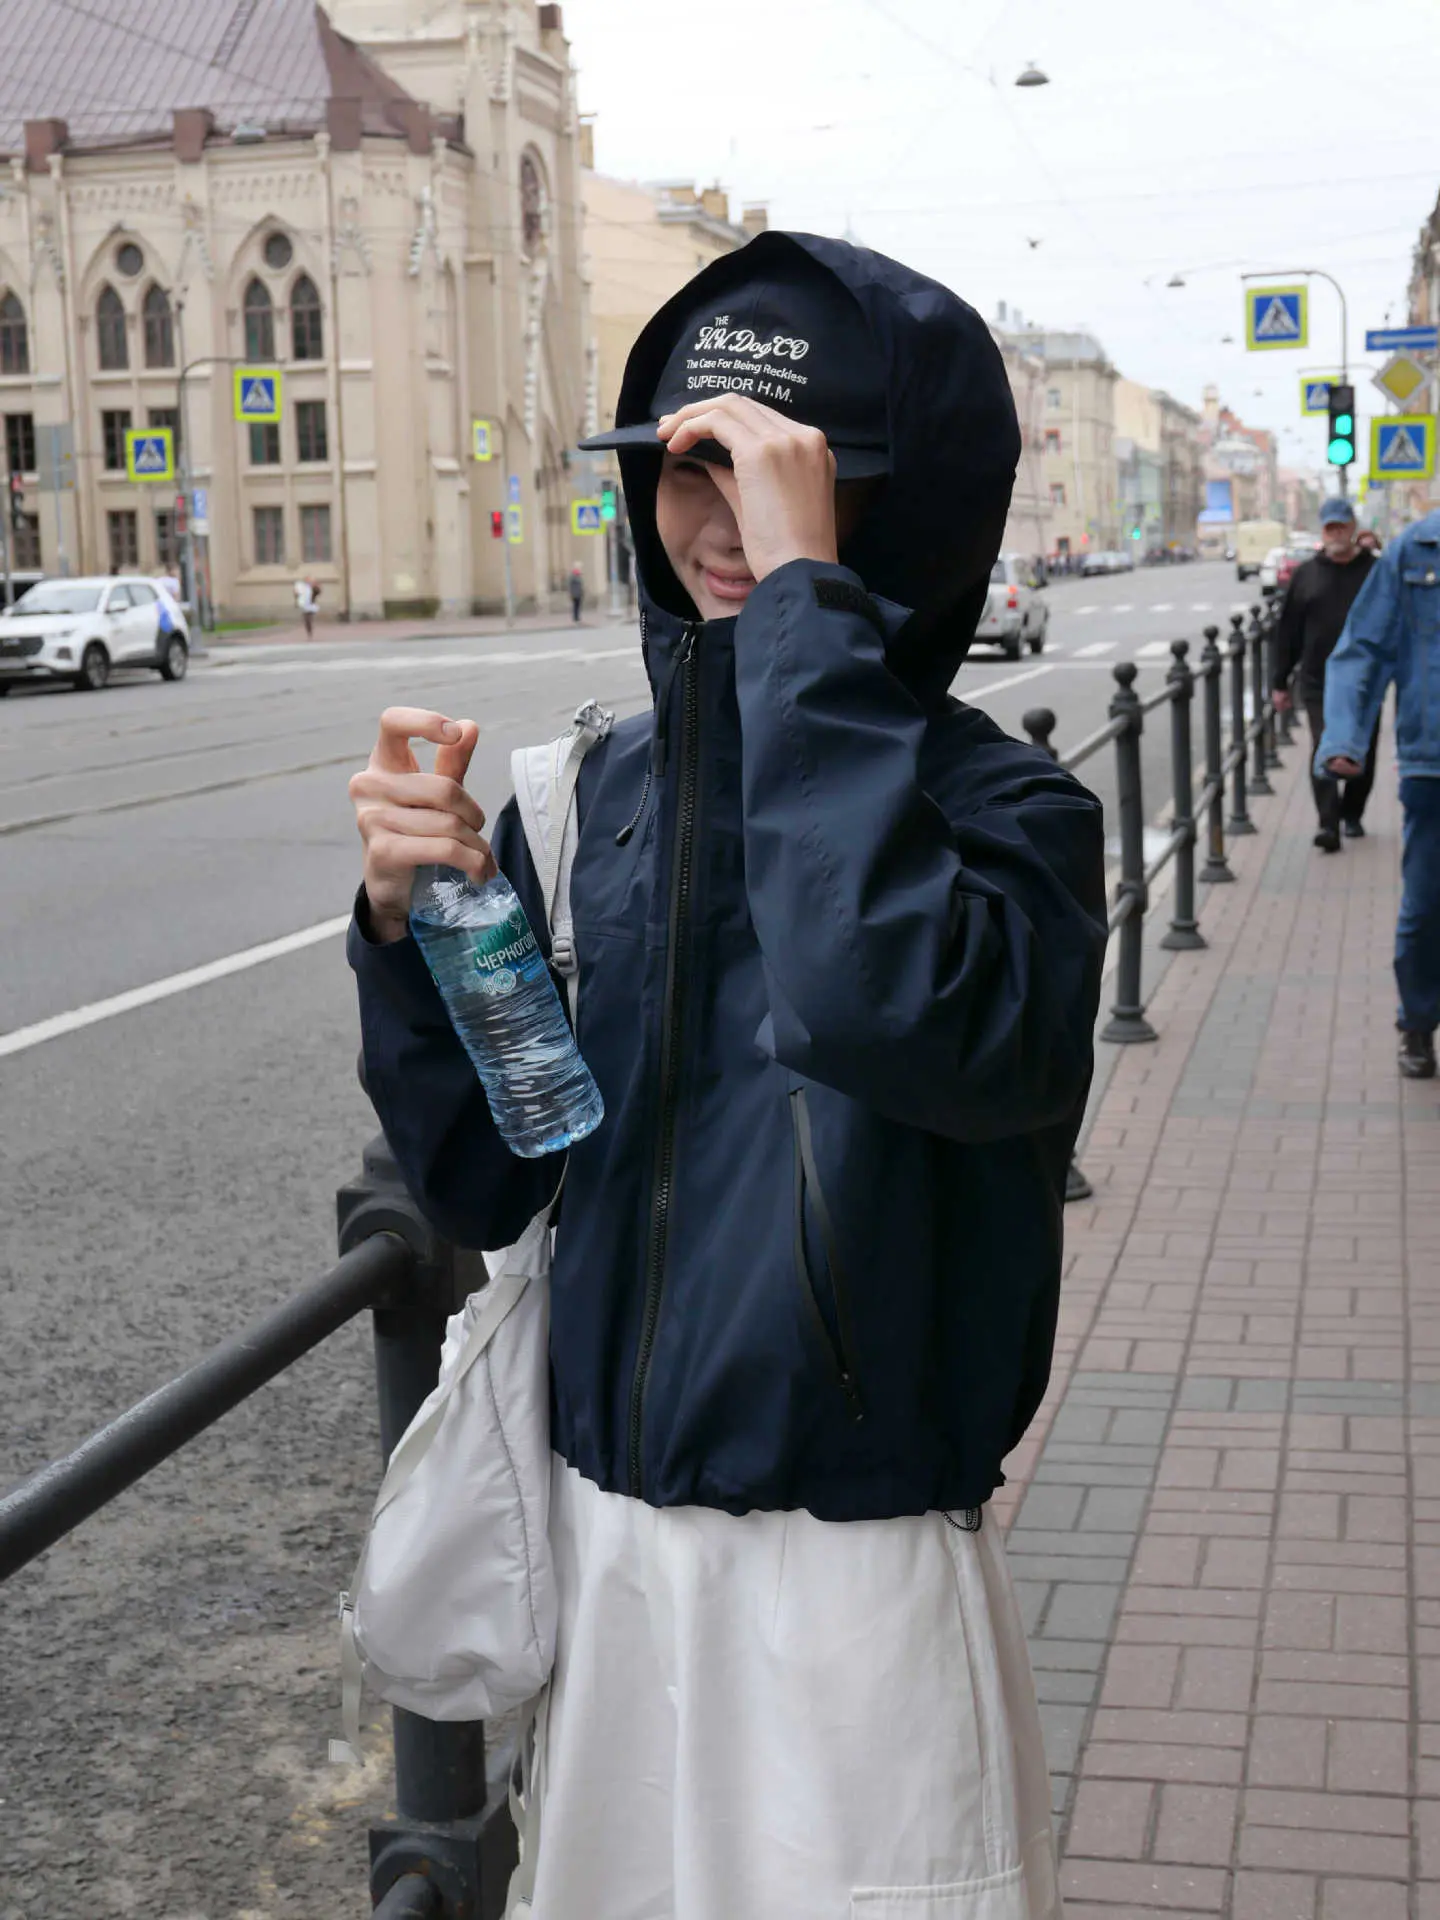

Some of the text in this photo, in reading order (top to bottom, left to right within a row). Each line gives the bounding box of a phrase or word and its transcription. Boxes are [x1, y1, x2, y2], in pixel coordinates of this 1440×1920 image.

[714, 314, 730, 327] THE
[686, 358, 808, 385] The Case For Being Reckless
[687, 375, 793, 403] SUPERIOR H.M.
